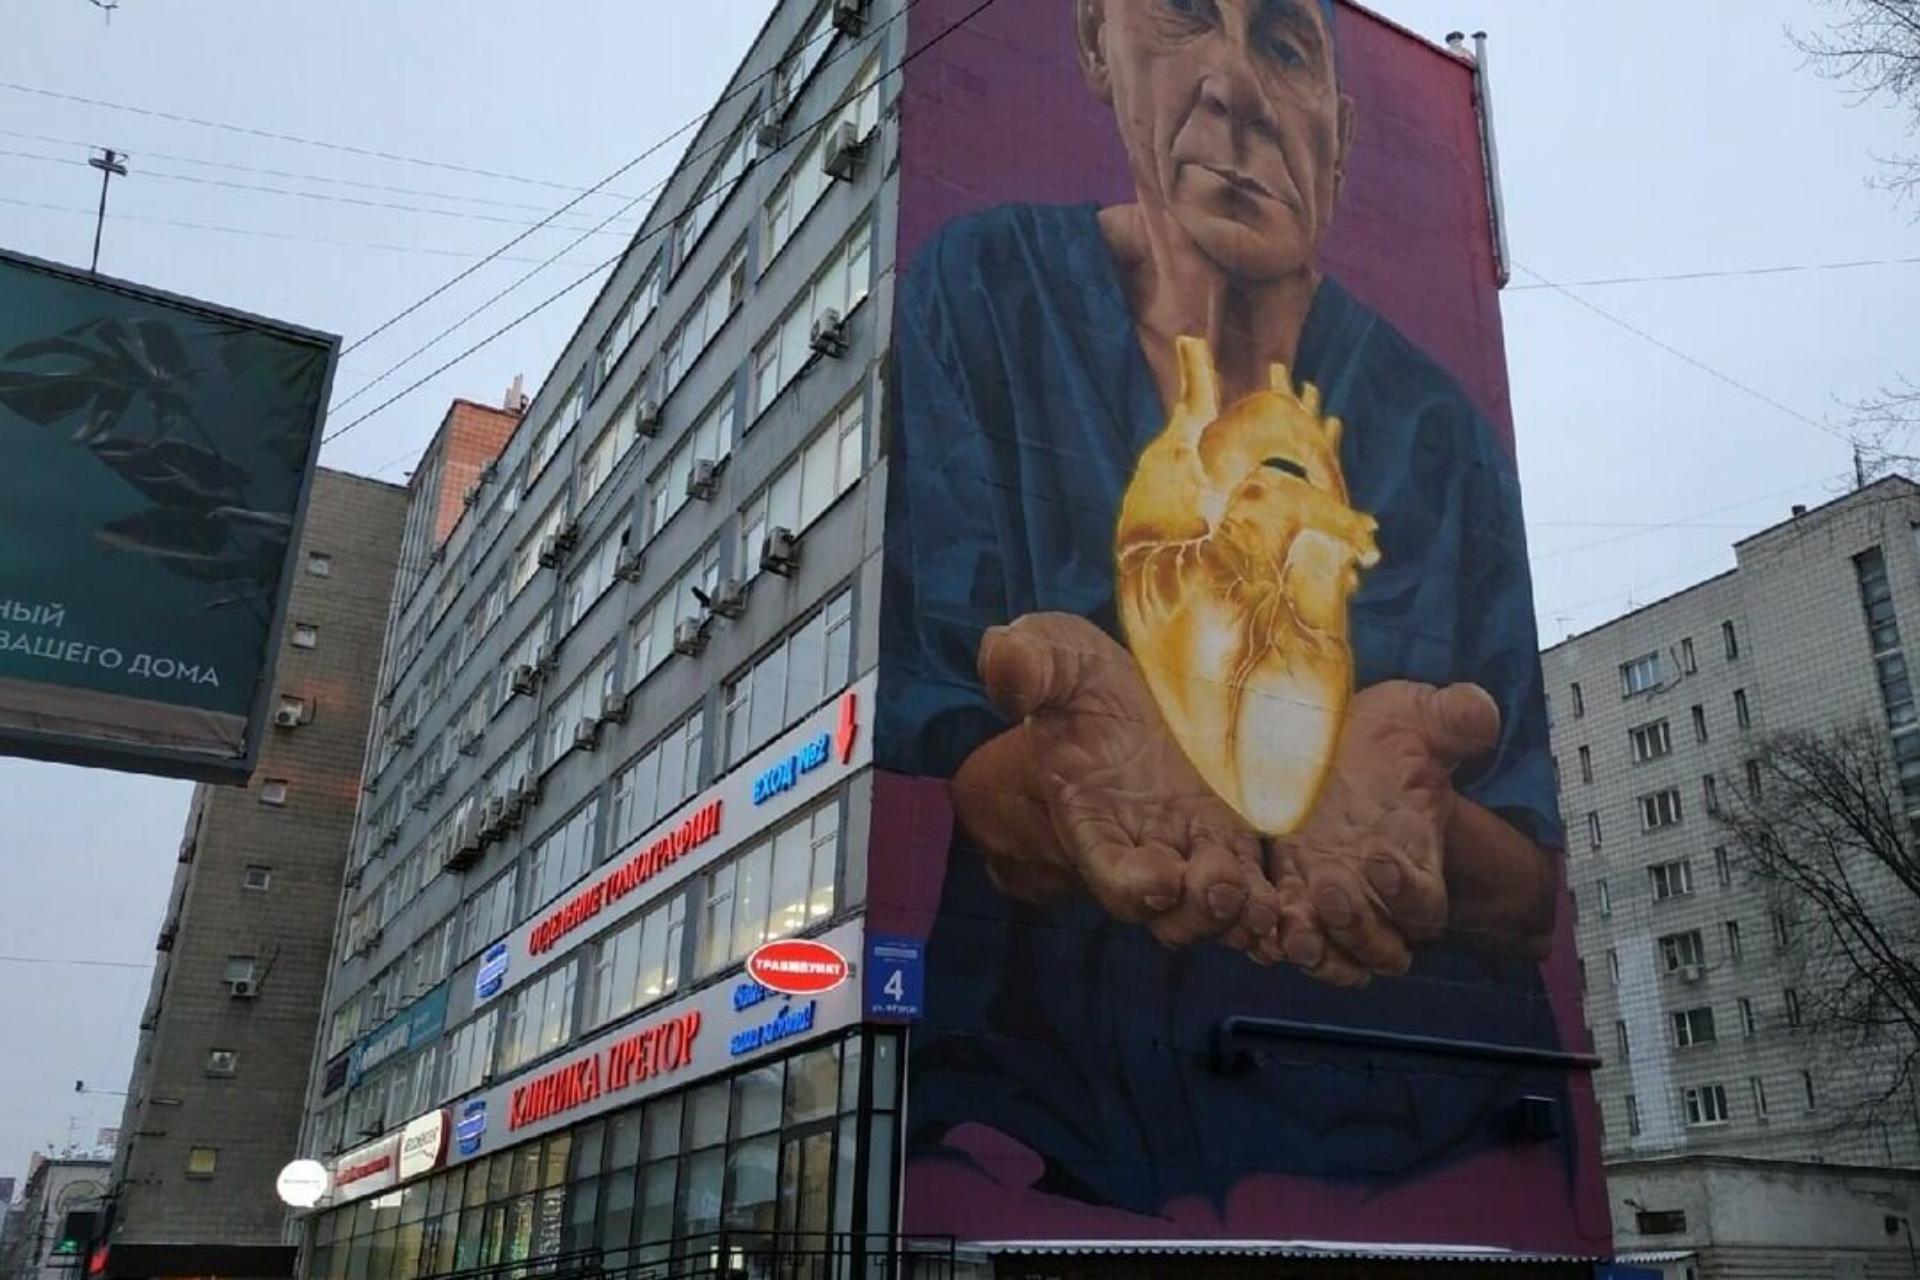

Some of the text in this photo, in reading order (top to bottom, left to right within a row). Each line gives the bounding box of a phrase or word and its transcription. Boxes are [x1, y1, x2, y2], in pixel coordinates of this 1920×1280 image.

[127, 653, 220, 687] ДОМА
[883, 969, 904, 1002] 4
[509, 1053, 602, 1132] КЛИНИКА
[604, 1010, 702, 1094] ПРЕТОР
